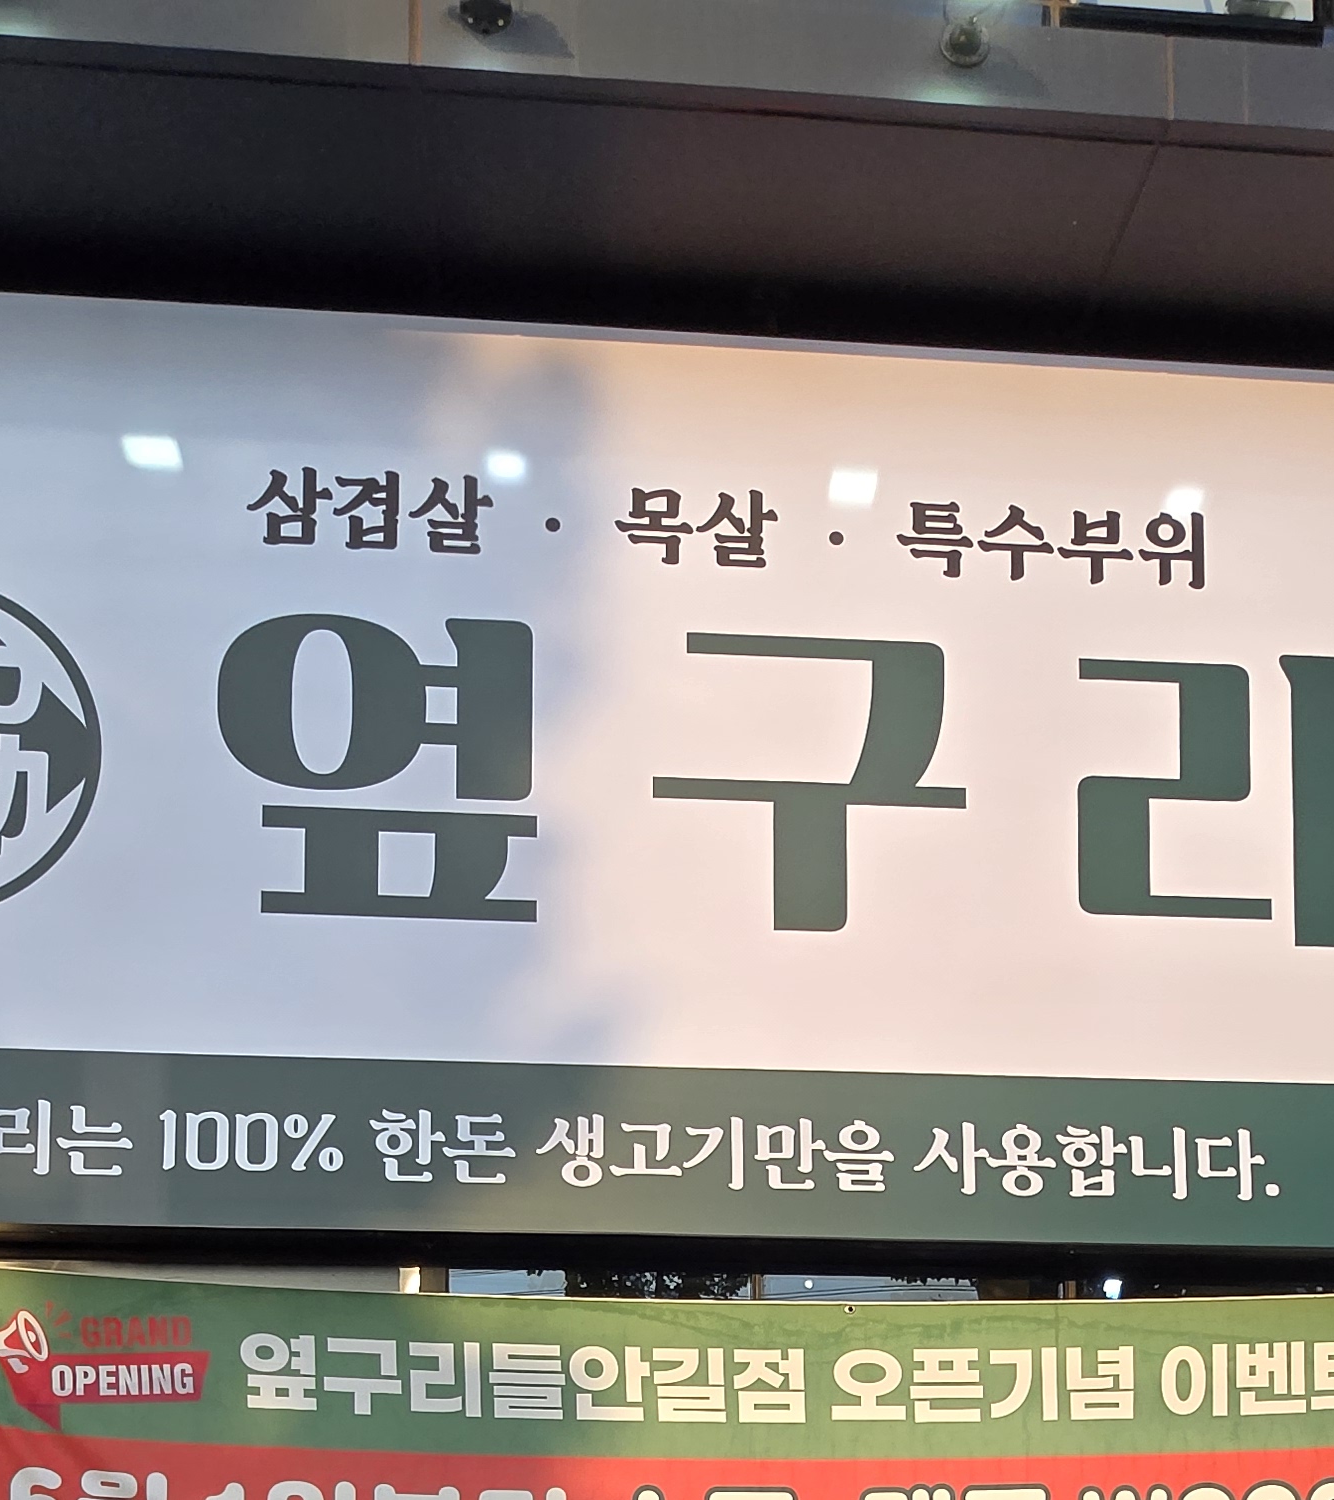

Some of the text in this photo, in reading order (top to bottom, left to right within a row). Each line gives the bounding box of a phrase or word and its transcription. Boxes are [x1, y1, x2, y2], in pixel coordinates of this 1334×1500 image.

[246, 467, 1209, 590] 삼겹살 목살 특수부위
[160, 1109, 344, 1172] 100%
[369, 1109, 517, 1184] 한돈
[536, 1113, 896, 1192] 생고기만을
[913, 1121, 1281, 1201] 사용합니다.
[80, 1315, 193, 1348] GRAND
[51, 1363, 195, 1397] OPENING
[240, 1332, 807, 1424] 옆구리들안길점
[831, 1344, 1135, 1424] 오픈기념
